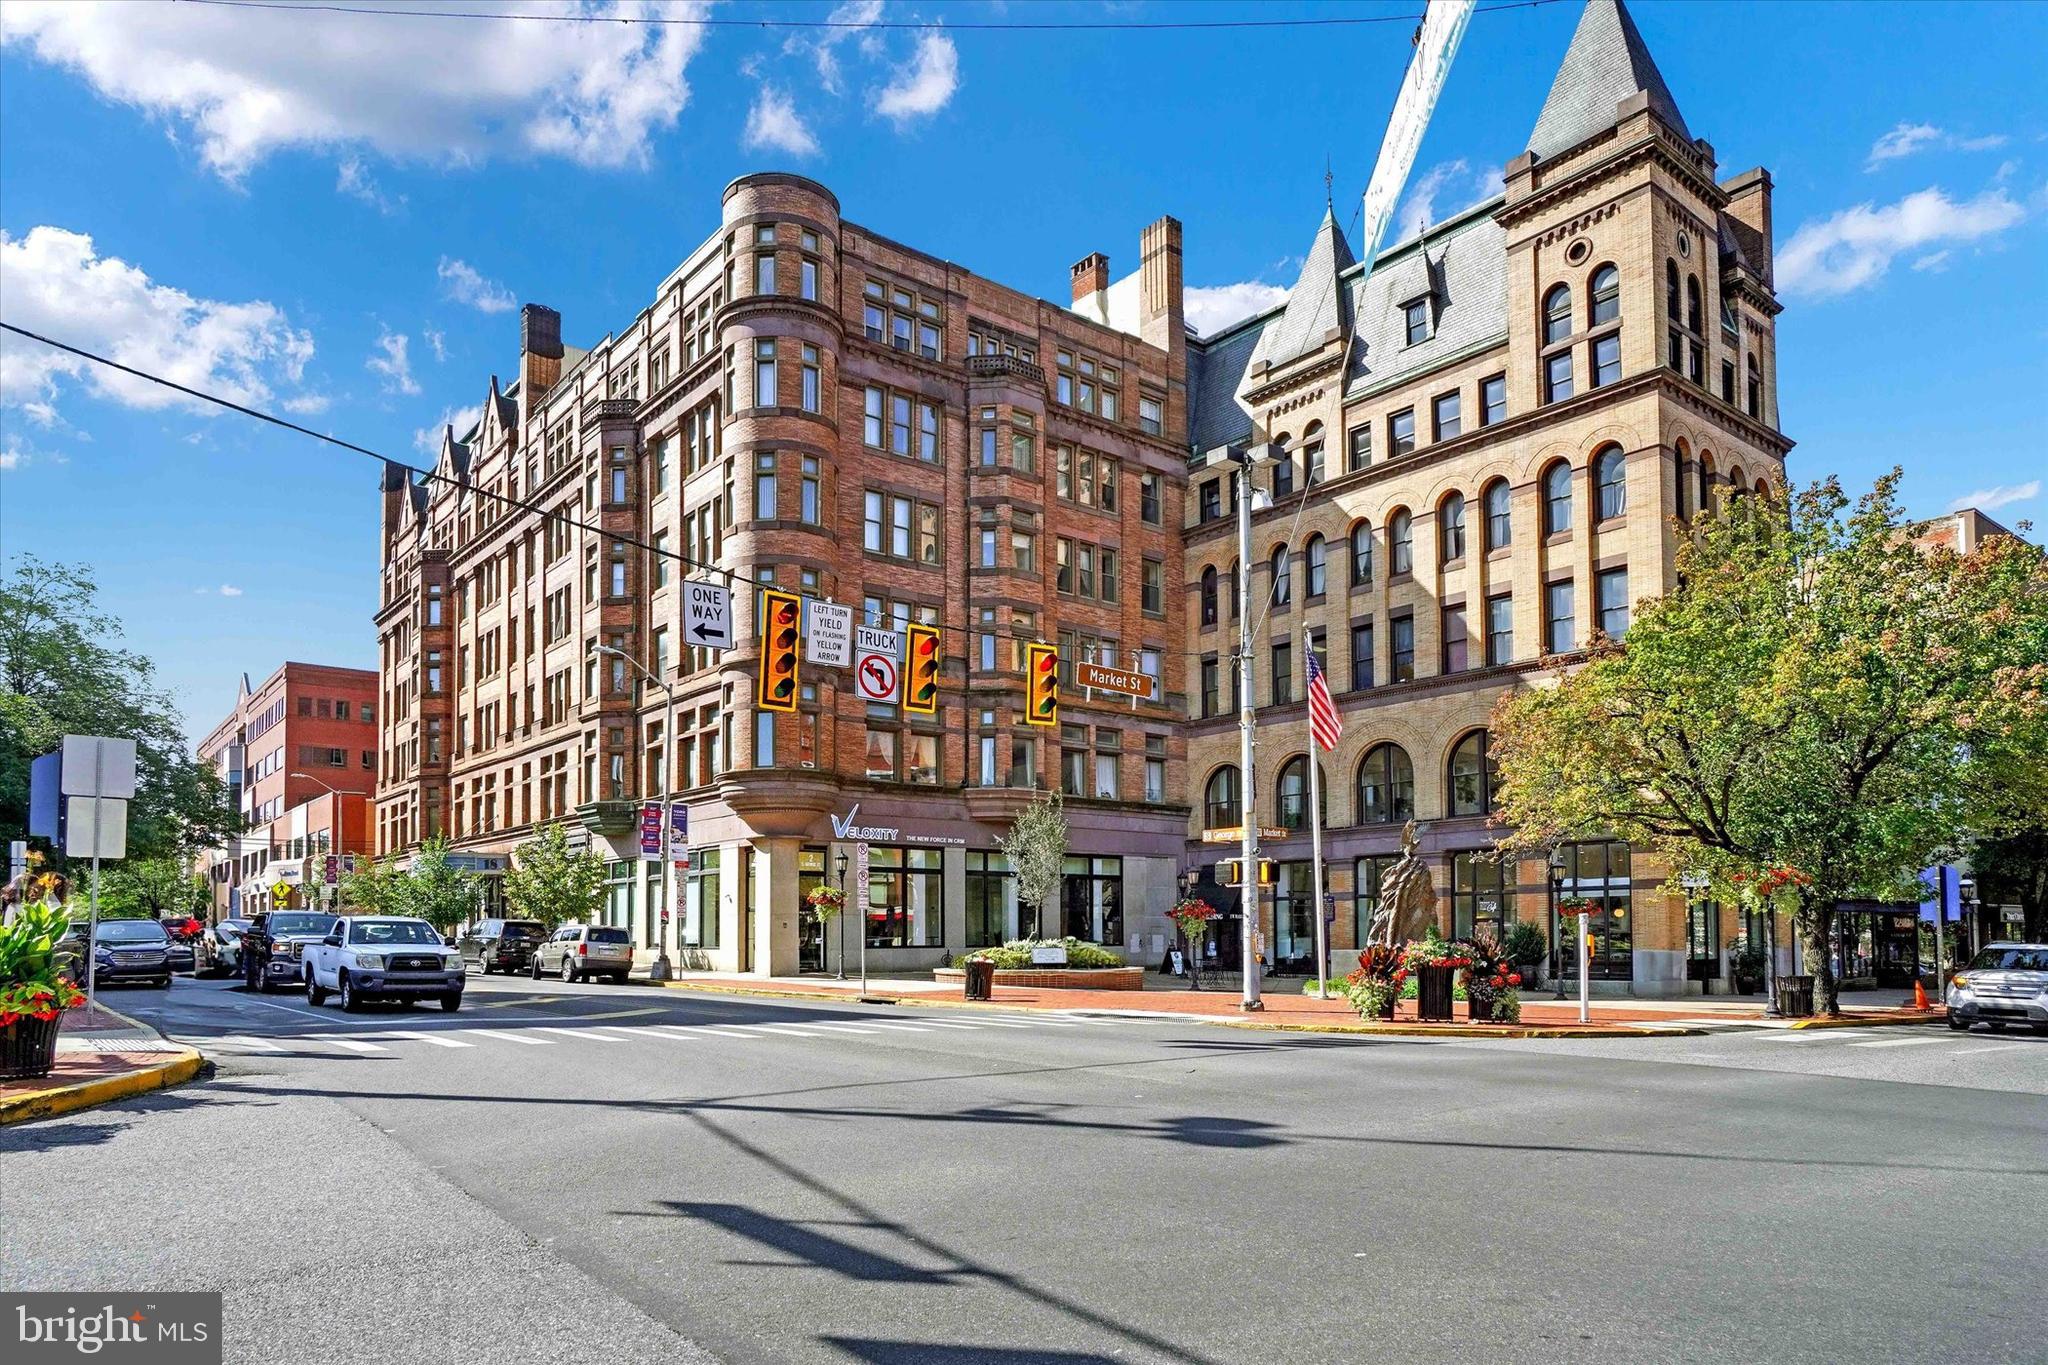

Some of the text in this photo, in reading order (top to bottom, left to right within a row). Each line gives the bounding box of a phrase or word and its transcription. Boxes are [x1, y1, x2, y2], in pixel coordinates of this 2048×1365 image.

[692, 587, 722, 606] ONE
[691, 604, 723, 621] WAY
[813, 605, 848, 618] LEFT TURN
[819, 617, 843, 630] YIELD
[812, 629, 847, 641] ON FLASHING
[858, 629, 896, 650] TRUCK
[816, 640, 843, 651] YELLOW
[817, 651, 841, 662] ARROW
[1089, 668, 1141, 691] Market St
[917, 835, 930, 843] NEW
[808, 854, 814, 862] 2
